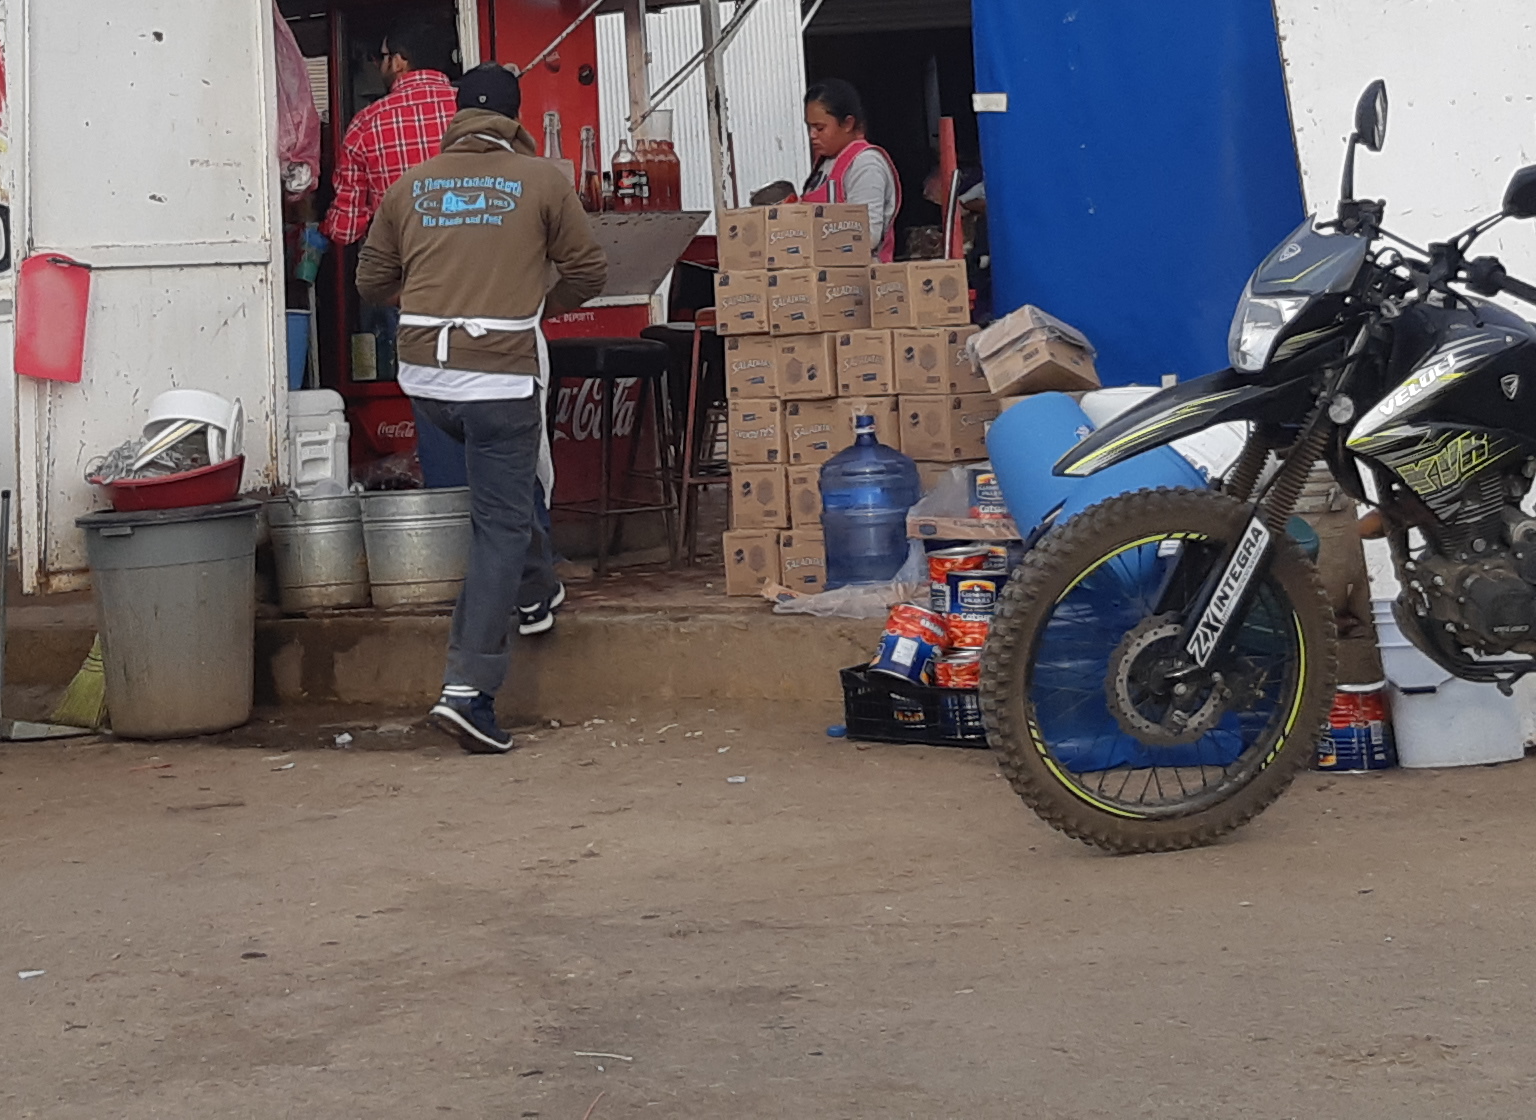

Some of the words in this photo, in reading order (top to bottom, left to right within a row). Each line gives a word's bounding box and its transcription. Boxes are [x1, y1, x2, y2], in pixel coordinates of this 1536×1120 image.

[463, 176, 495, 187] Catholic
[495, 177, 523, 198] Church
[465, 214, 482, 224] and
[1214, 524, 1264, 614] INTEGRA
